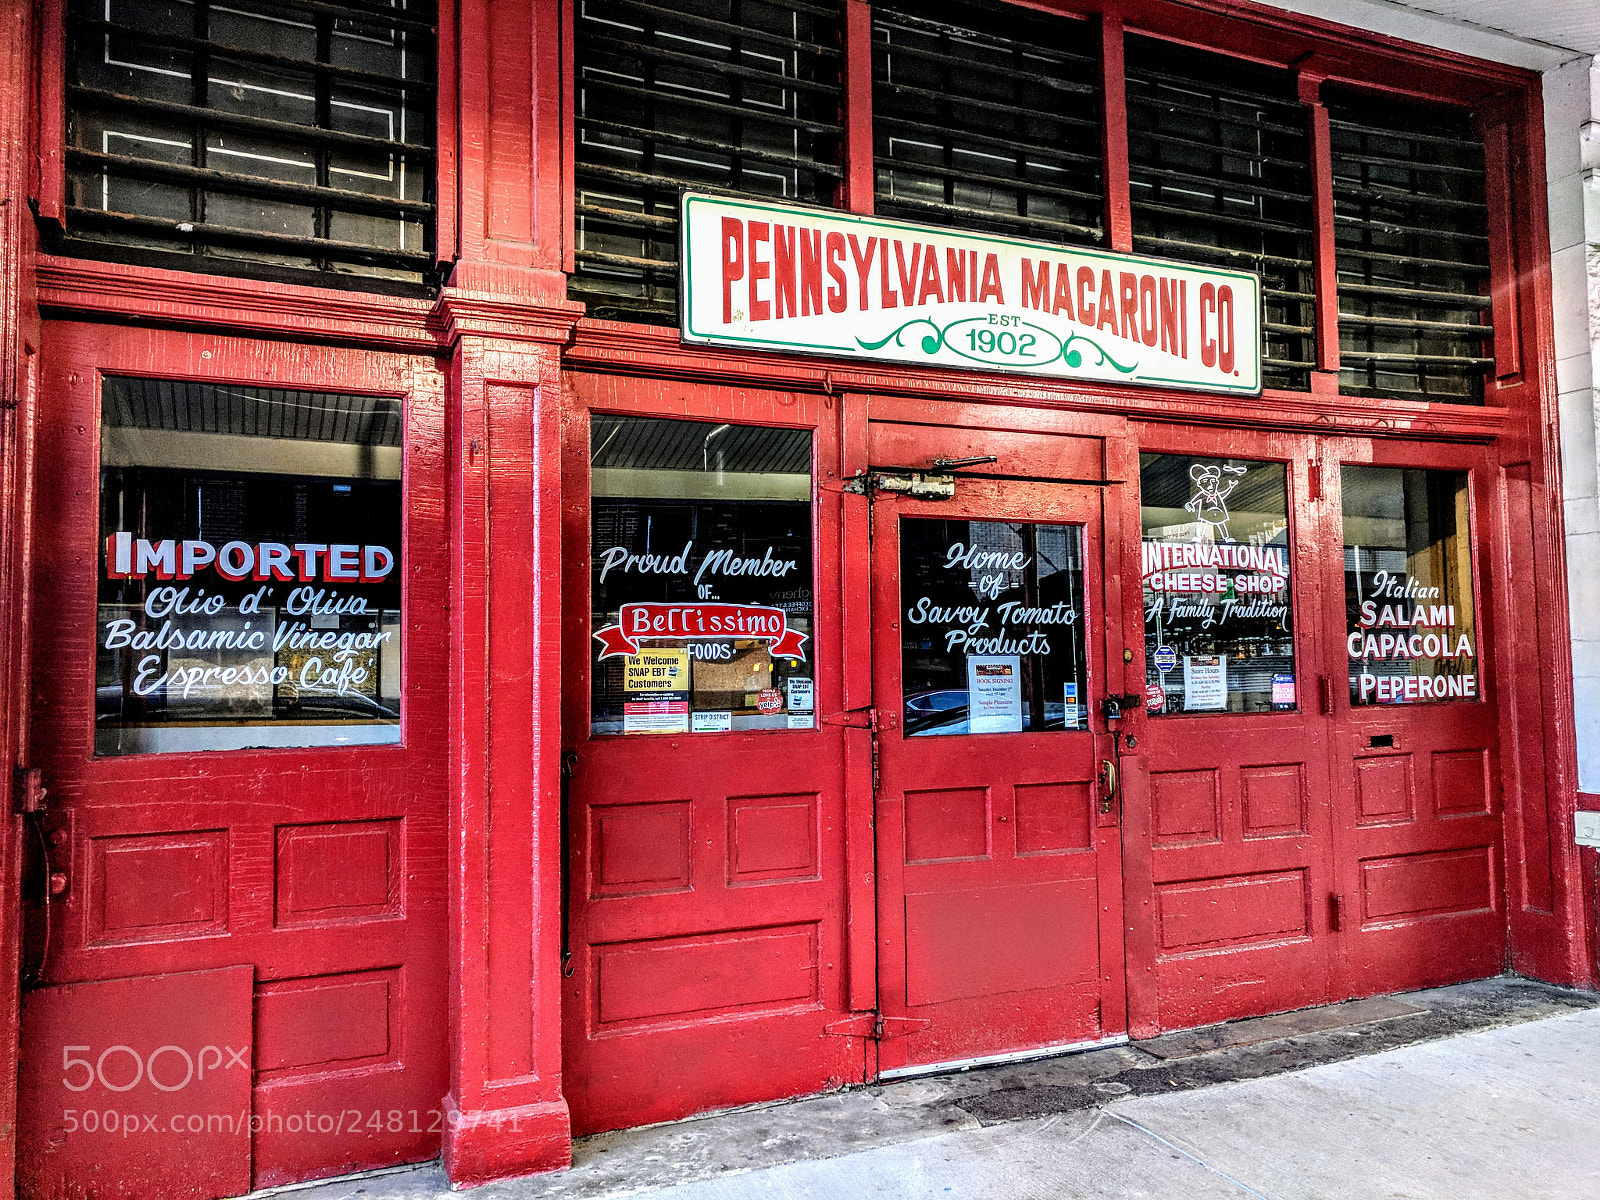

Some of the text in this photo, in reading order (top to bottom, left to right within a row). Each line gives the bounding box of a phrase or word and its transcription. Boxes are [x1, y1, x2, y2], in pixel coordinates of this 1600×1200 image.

[721, 216, 1240, 377] PENNSYLVANIA MACARONI CO.
[988, 314, 1021, 327] EST
[965, 330, 1037, 357] 1902
[107, 532, 394, 582] IMPORTED
[599, 540, 798, 586] Proud Member
[942, 542, 1032, 570] Home
[1141, 541, 1288, 580] INTERNATIONAL
[979, 572, 1010, 600] of
[1149, 573, 1287, 594] CHEESE SHOP
[1370, 569, 1439, 598] Italian
[144, 586, 227, 618] Olio
[286, 585, 368, 616] Oliva
[1145, 597, 1290, 632] A Family Tradition
[1359, 600, 1455, 628] SALAMI
[631, 607, 781, 632] Bellissimo
[908, 596, 1079, 636] Savoy Tomato
[104, 618, 392, 663] Balsamic Vinegar
[687, 643, 731, 661] FOODS
[944, 627, 1051, 655] Products
[1347, 631, 1473, 660] CAPACOLA
[628, 656, 679, 665] We Welcome
[628, 667, 667, 677] SNAP EBT
[132, 655, 289, 699] Espresso
[628, 679, 672, 689] Customers
[1359, 673, 1476, 702] PEPERONE
[759, 700, 775, 710] yelp
